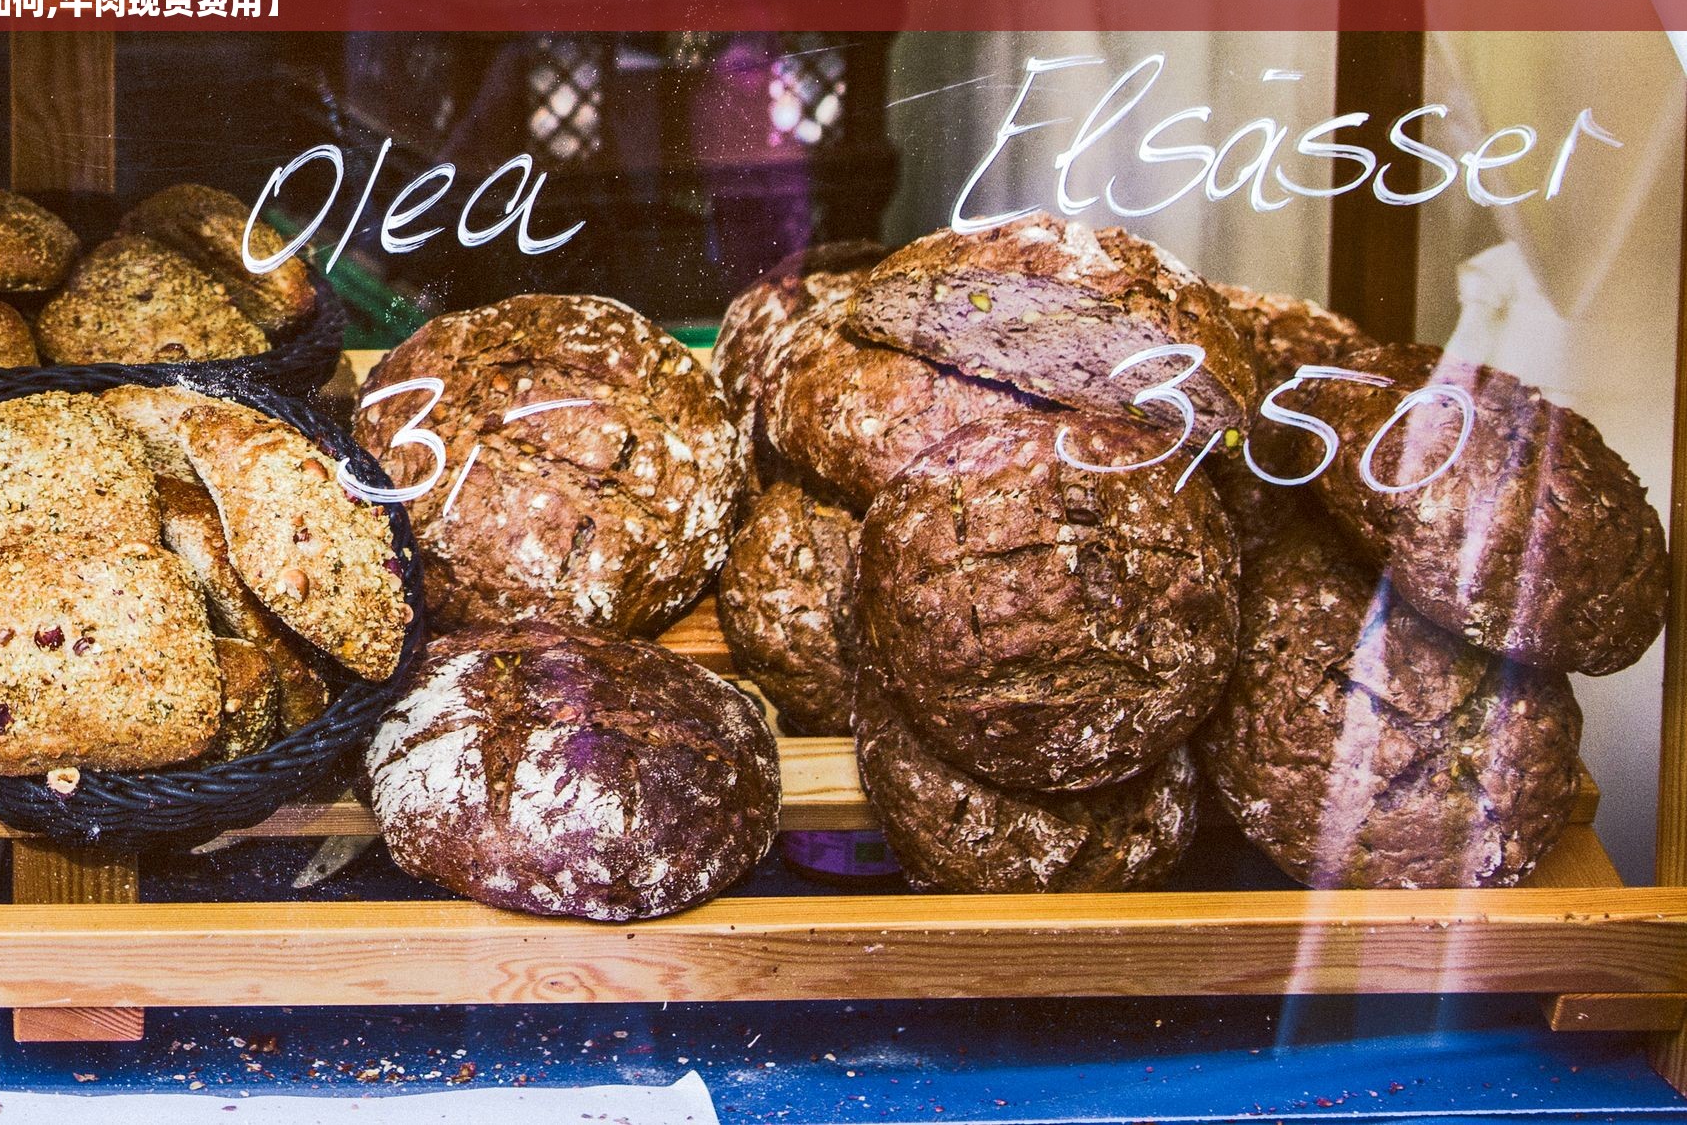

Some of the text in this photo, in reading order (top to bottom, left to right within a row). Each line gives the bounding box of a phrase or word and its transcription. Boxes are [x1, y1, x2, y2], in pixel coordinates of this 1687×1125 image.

[242, 137, 586, 275] Olea
[950, 52, 1624, 234] Elsässer
[1055, 343, 1474, 494] 3,50
